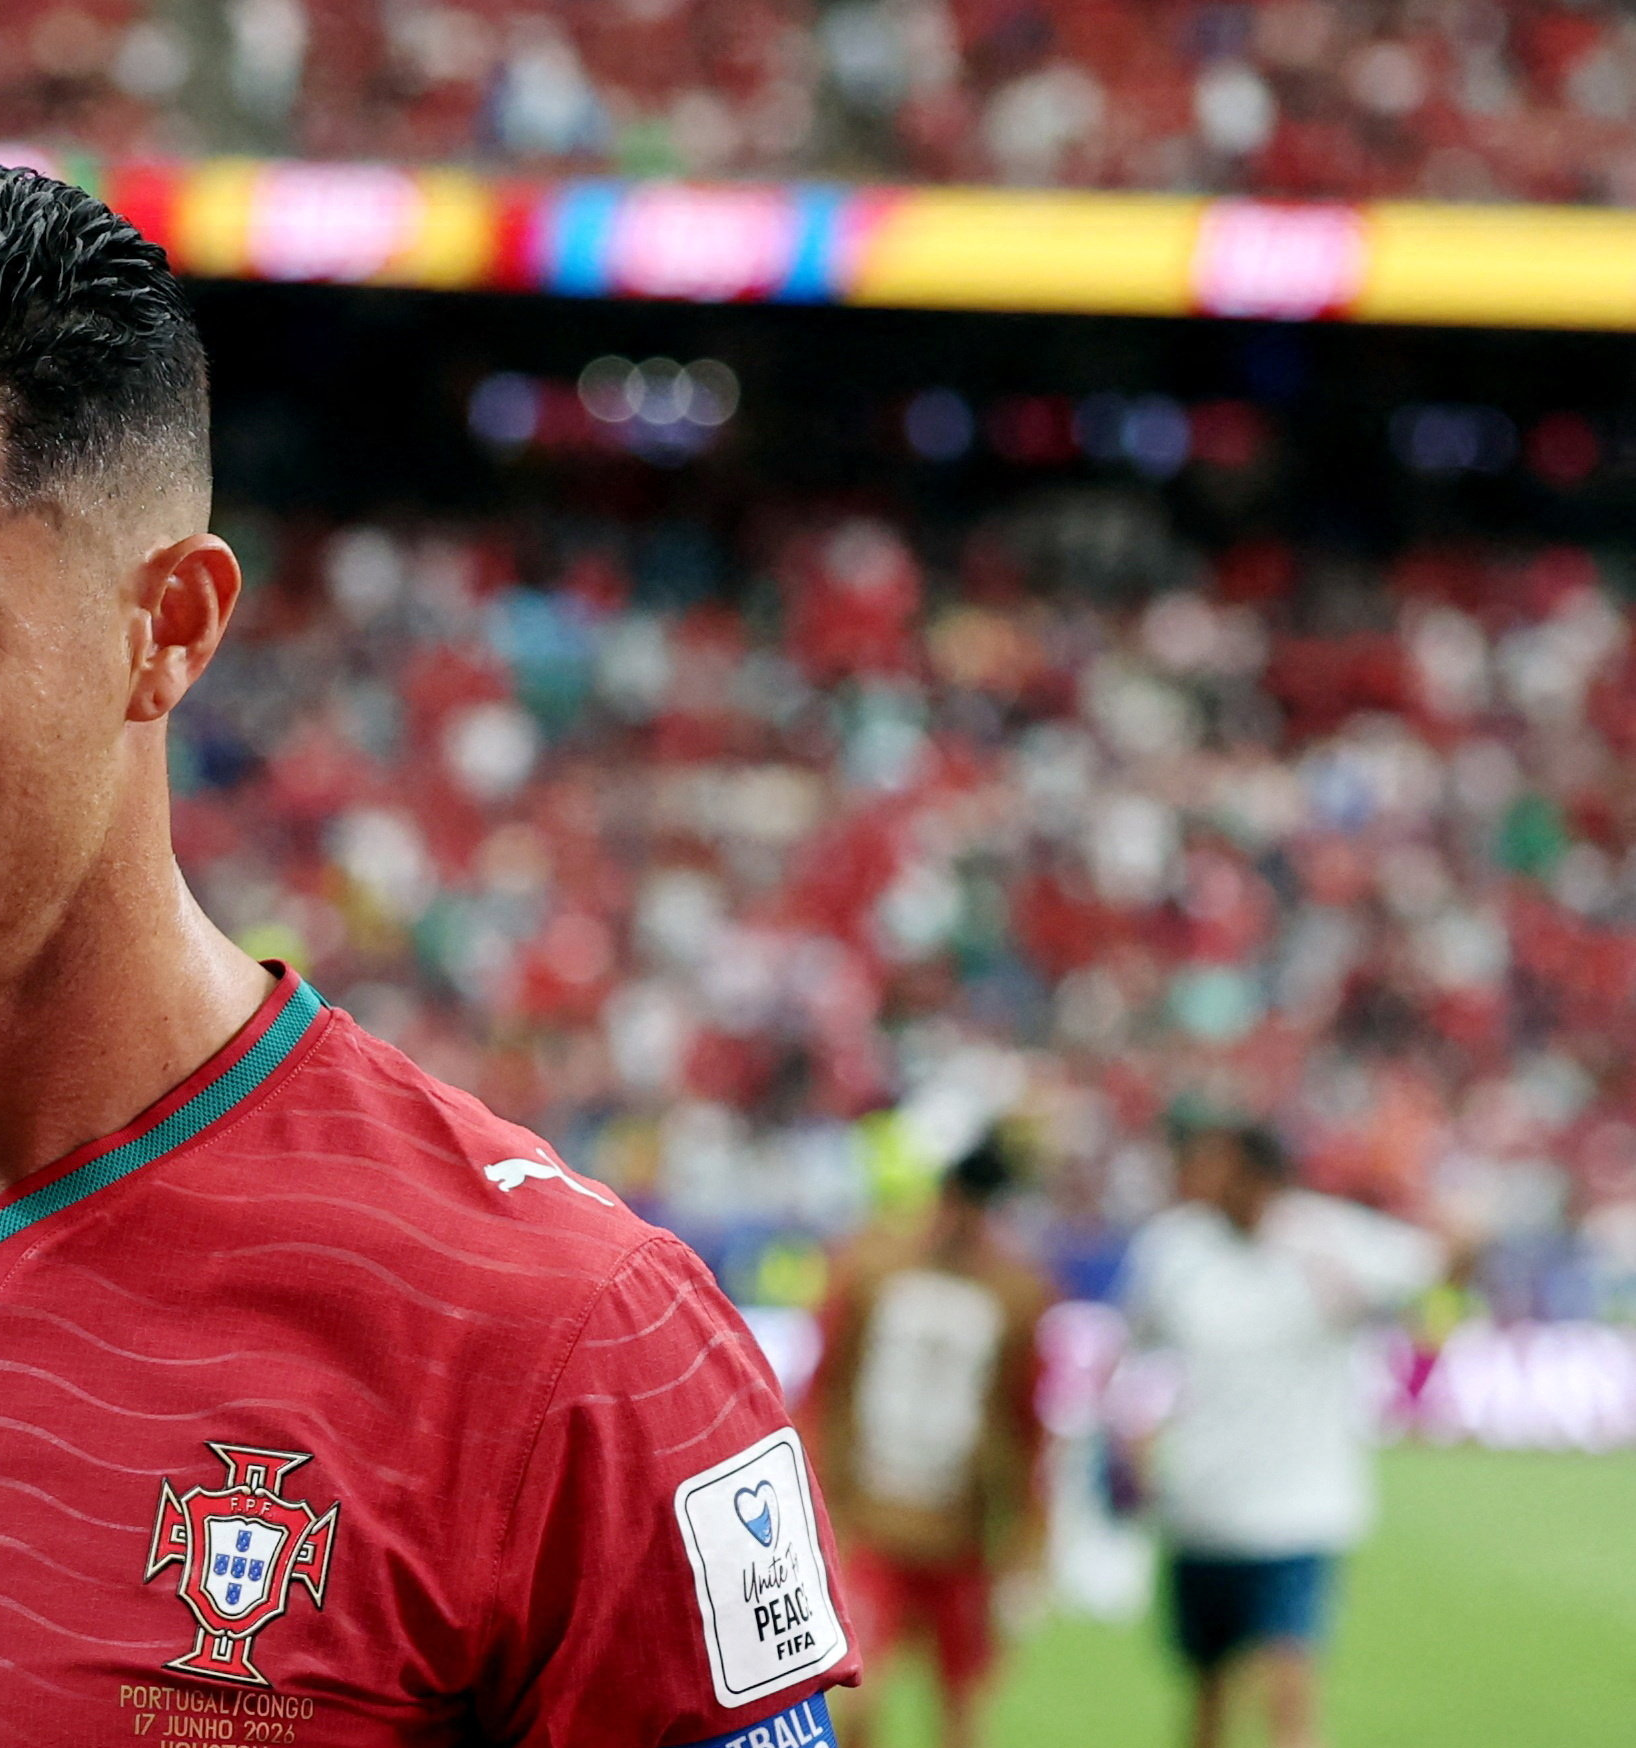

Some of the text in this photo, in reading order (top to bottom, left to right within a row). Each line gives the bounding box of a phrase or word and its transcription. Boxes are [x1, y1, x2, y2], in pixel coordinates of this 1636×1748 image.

[742, 1555, 788, 1604] Unite
[754, 1582, 813, 1643] PEAC
[776, 1630, 816, 1661] FIFA
[119, 1684, 315, 1720] PORTUGAL/CONGO
[133, 1713, 296, 1745] 17 JUNHO 2026
